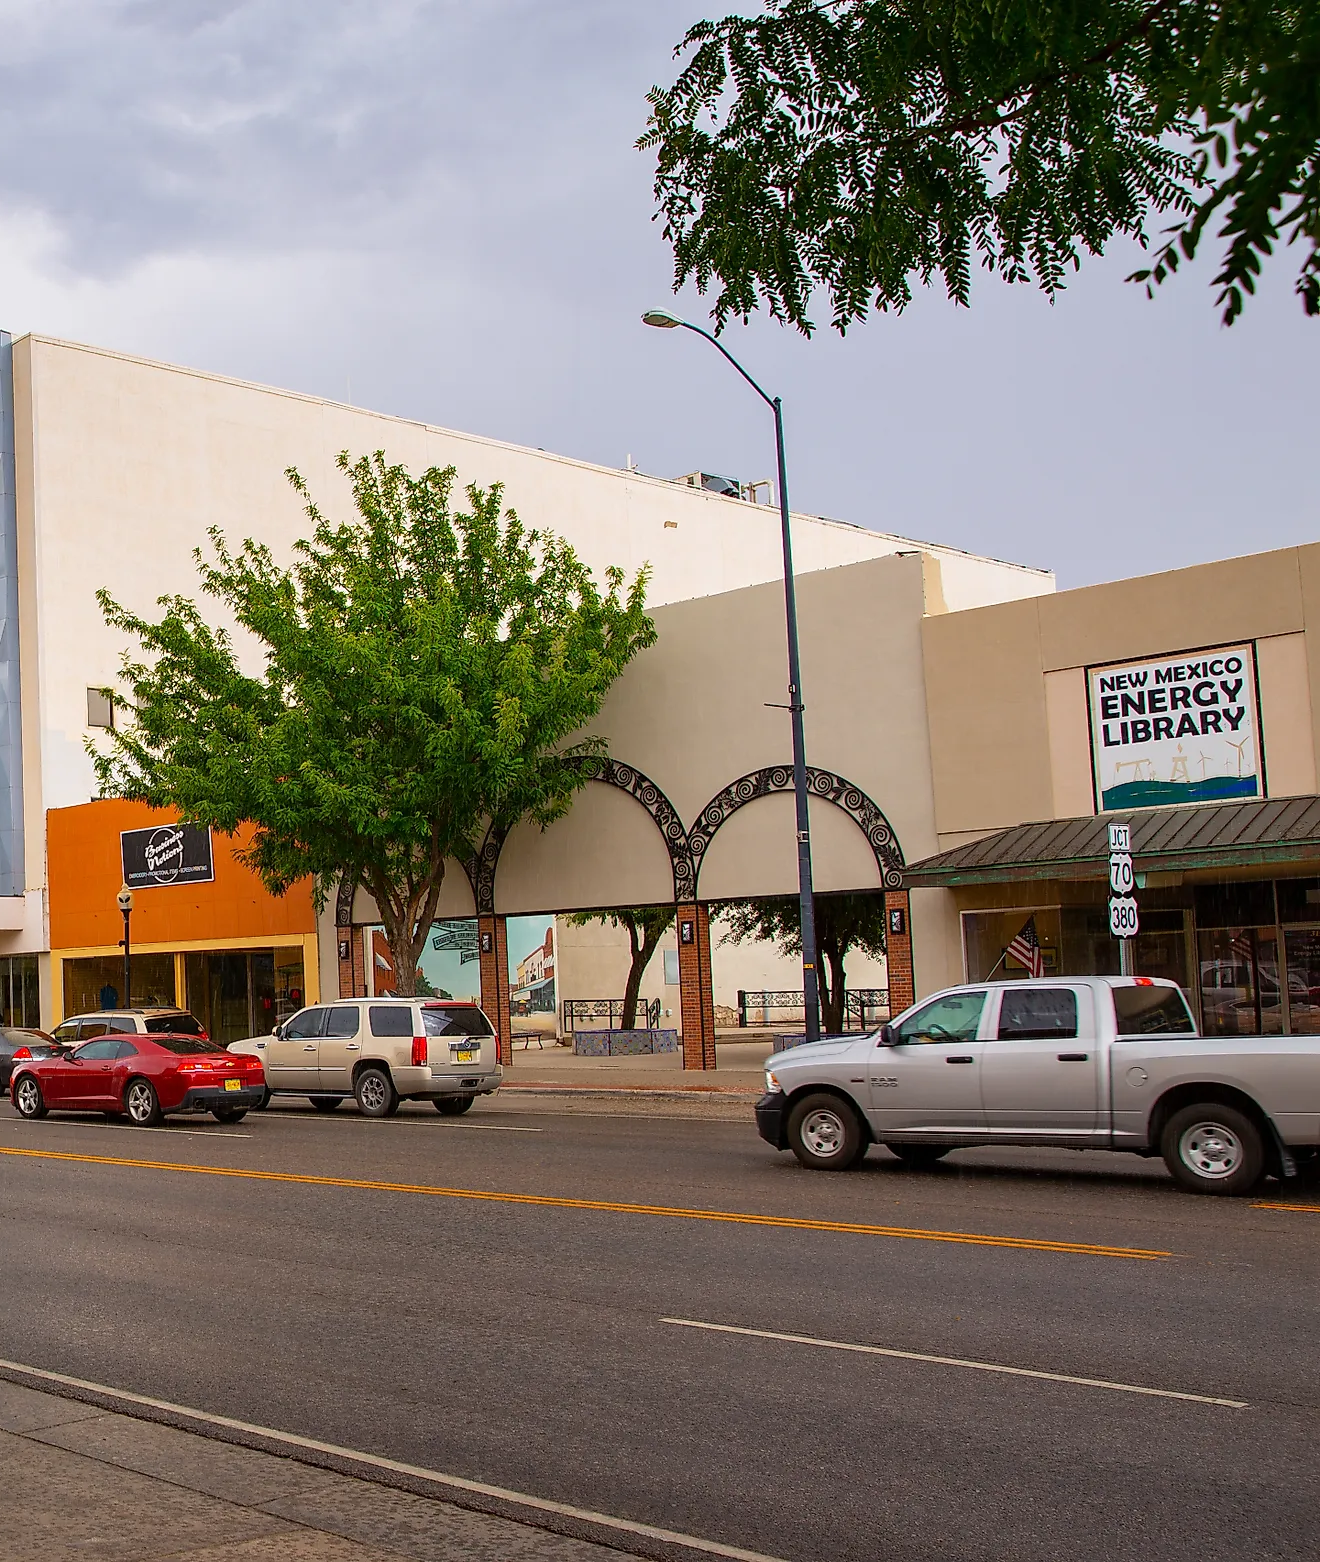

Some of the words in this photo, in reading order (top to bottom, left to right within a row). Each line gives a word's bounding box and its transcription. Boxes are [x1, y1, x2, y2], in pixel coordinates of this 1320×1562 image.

[1099, 670, 1148, 693] NEW
[1154, 656, 1243, 685] MEXICO
[1100, 678, 1243, 720] ENERGY
[1102, 706, 1246, 748] LIBRARY
[144, 831, 184, 858] Business
[1111, 829, 1128, 847] JCT
[147, 844, 184, 871] Notions
[1111, 862, 1131, 886] 70
[1112, 906, 1136, 929] 380
